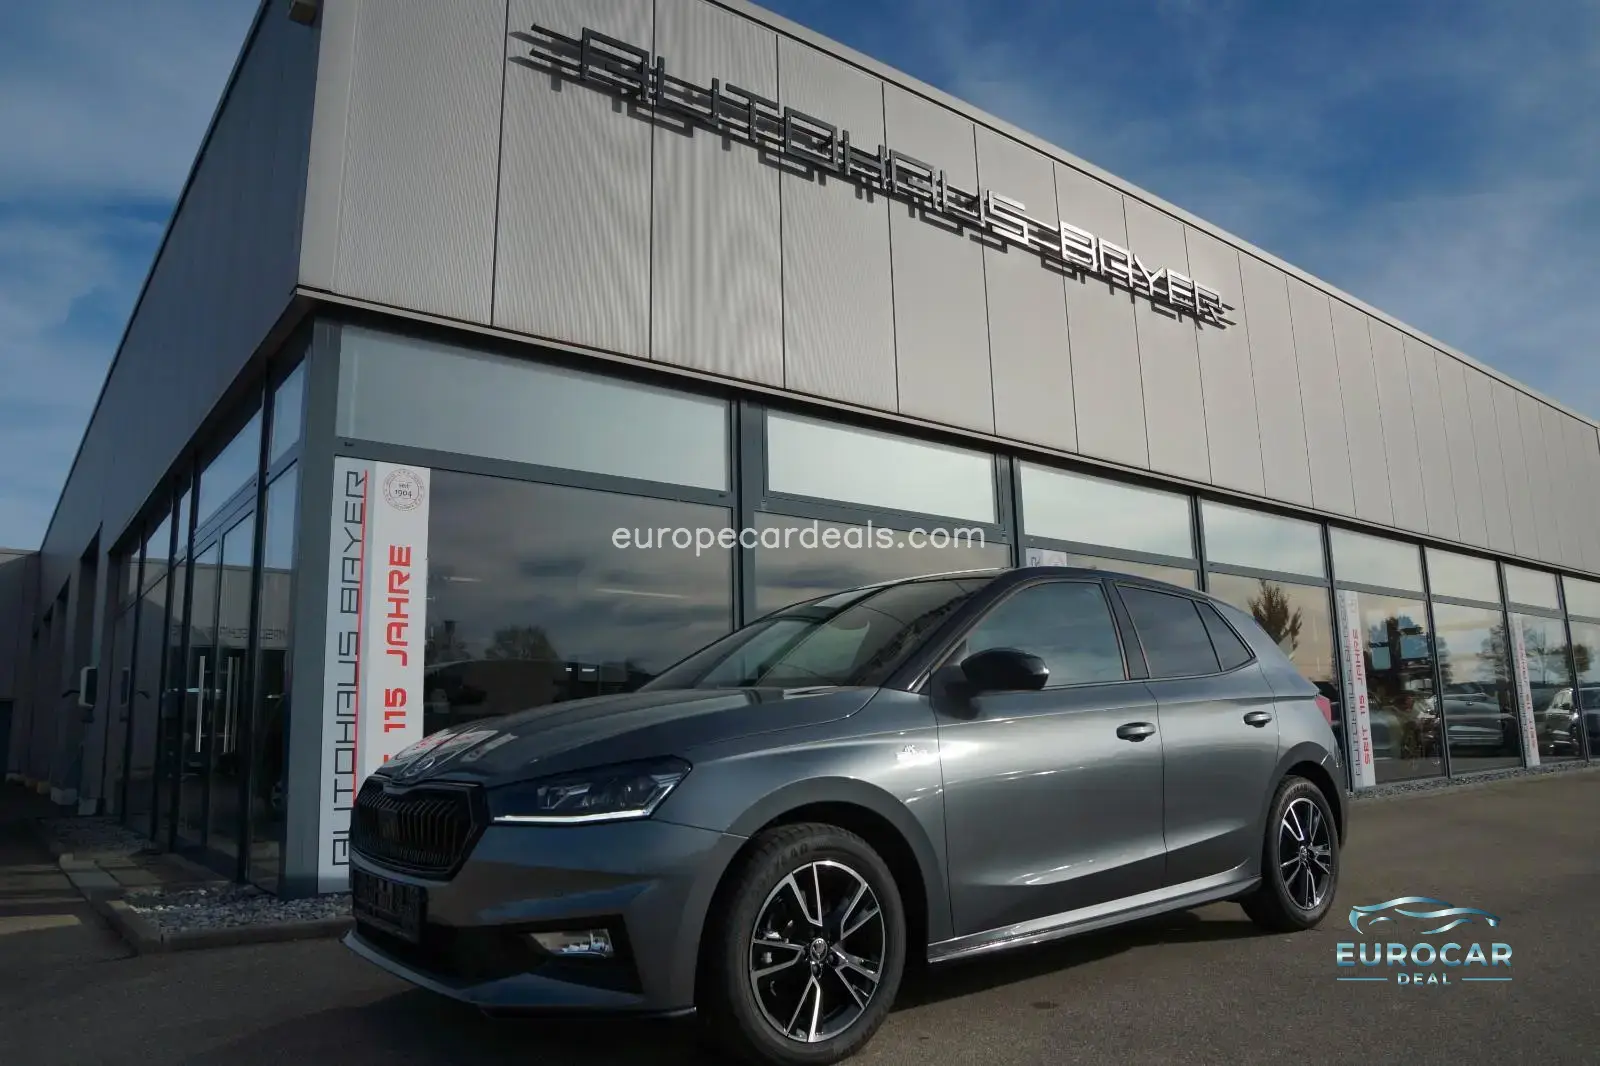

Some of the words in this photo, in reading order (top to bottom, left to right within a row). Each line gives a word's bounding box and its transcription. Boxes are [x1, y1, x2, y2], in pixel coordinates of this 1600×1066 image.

[581, 27, 1029, 246] AUTOHAUS
[1059, 220, 1222, 326] BAYER
[340, 470, 366, 614] BAYER
[395, 489, 412, 499] 1904
[386, 543, 412, 666] JAHRE
[332, 632, 360, 867] AUTOHAUS
[384, 687, 407, 732] 115
[1361, 725, 1371, 764] SEIT
